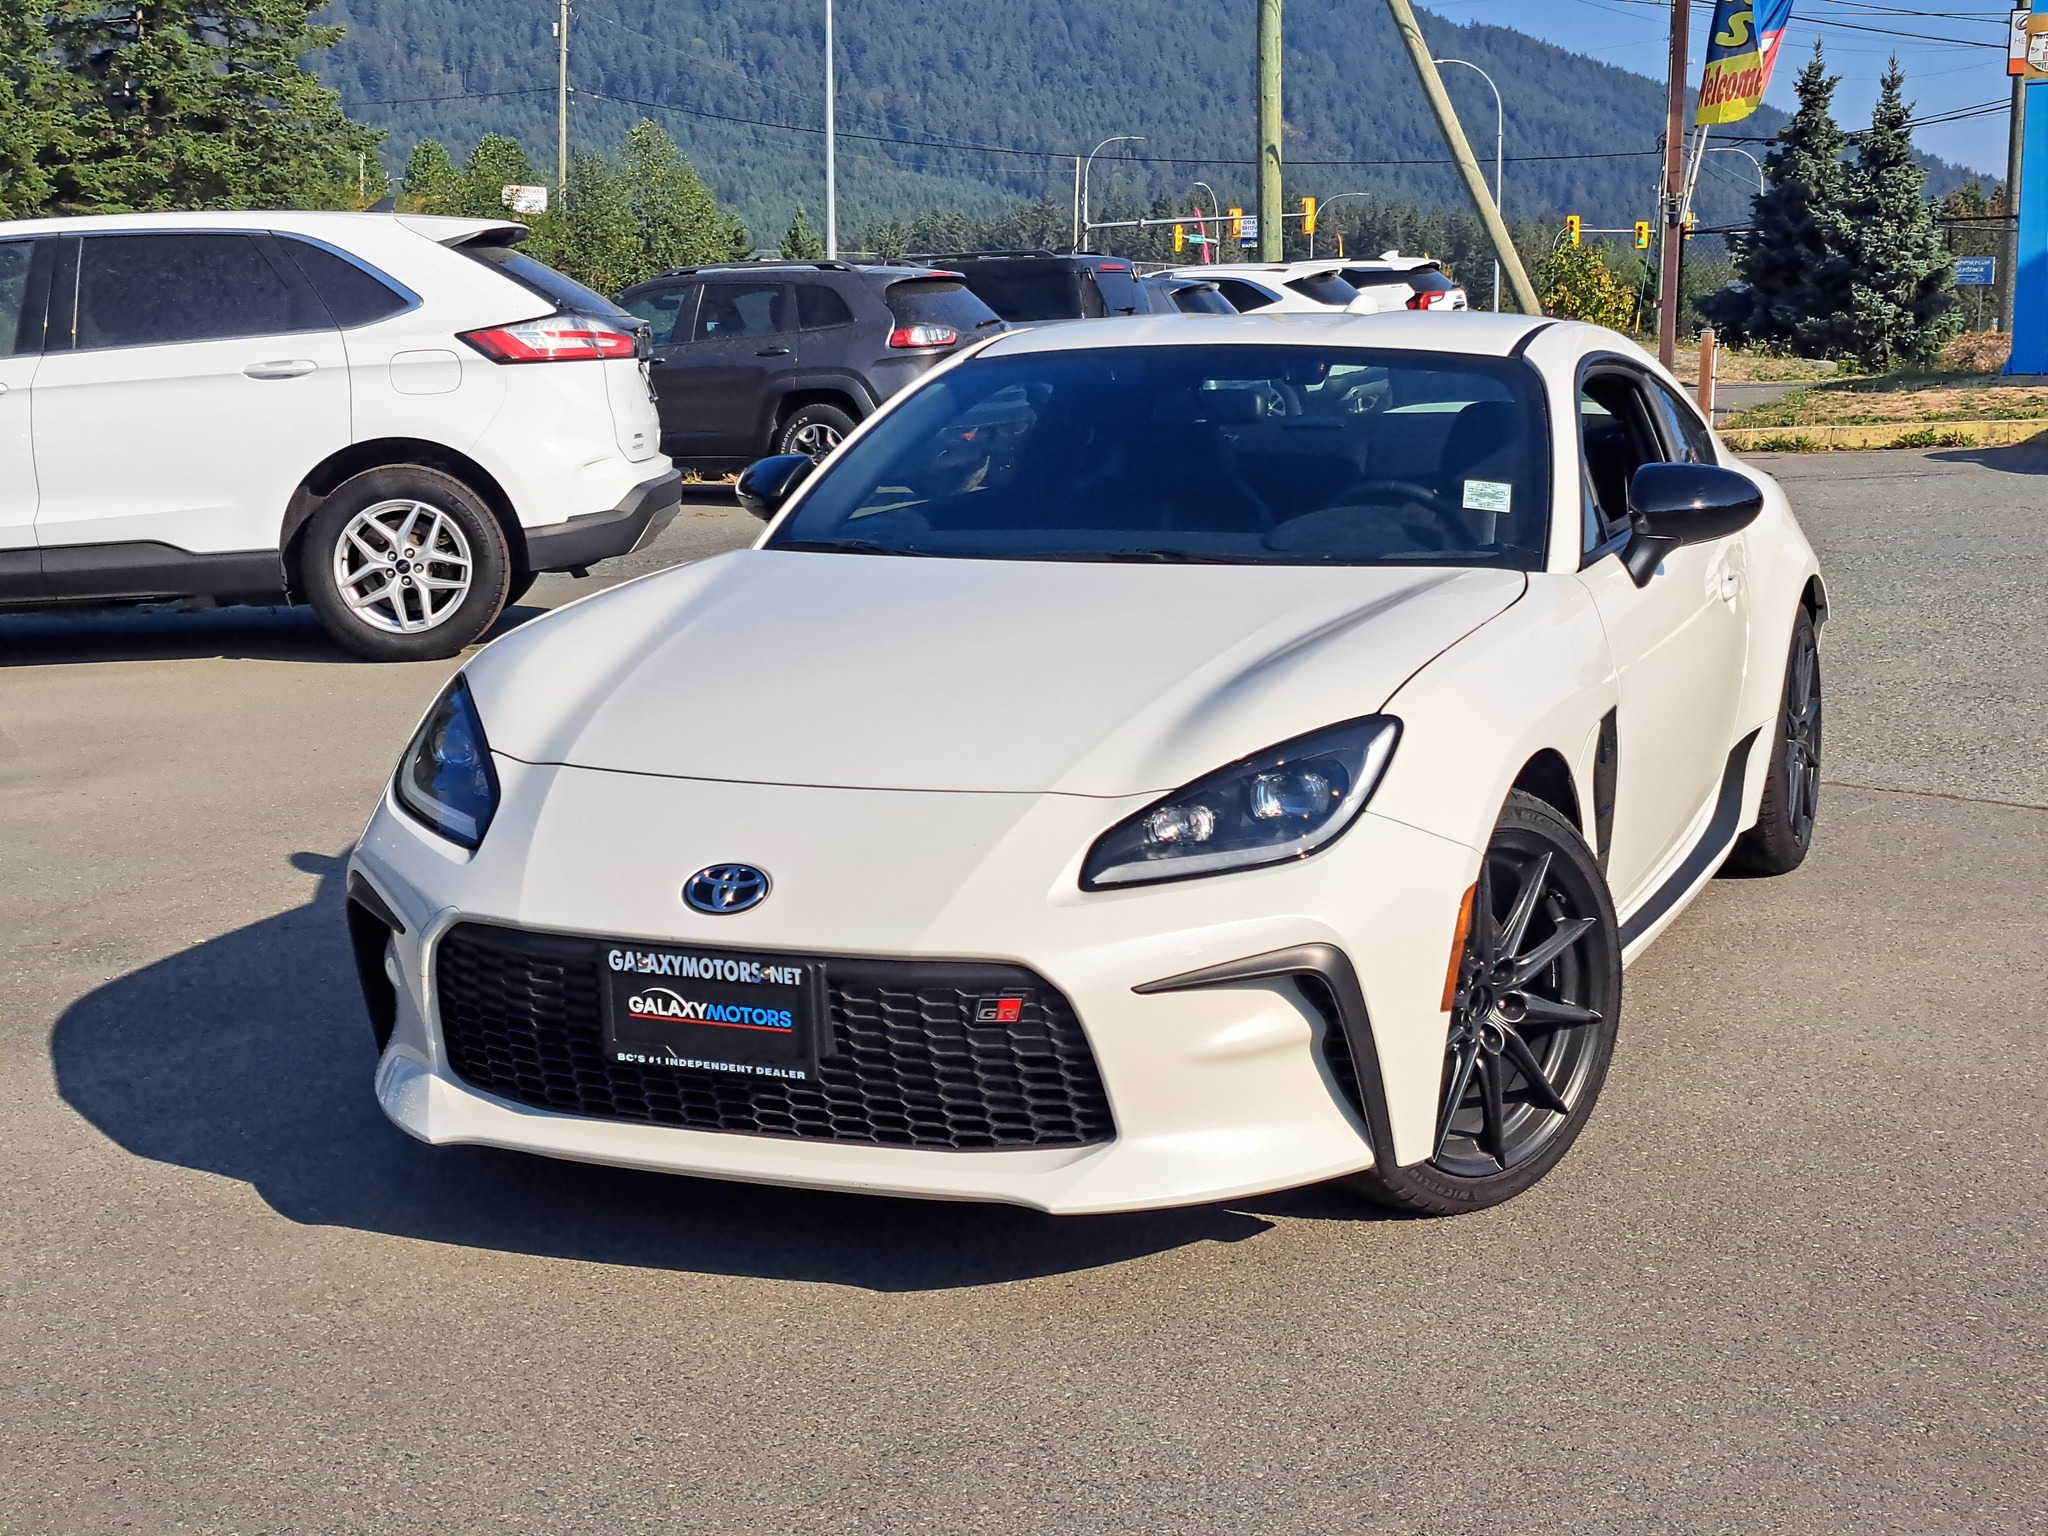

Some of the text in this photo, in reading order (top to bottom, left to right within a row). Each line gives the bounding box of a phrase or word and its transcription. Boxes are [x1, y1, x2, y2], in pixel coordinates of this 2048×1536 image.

[608, 949, 802, 985] GALAXYMOTORSNET
[628, 994, 793, 1029] GALAXYMOTORS
[978, 1007, 1017, 1020] GR
[617, 1052, 806, 1080] BC'S #1 INDEPENDENT DEALER
